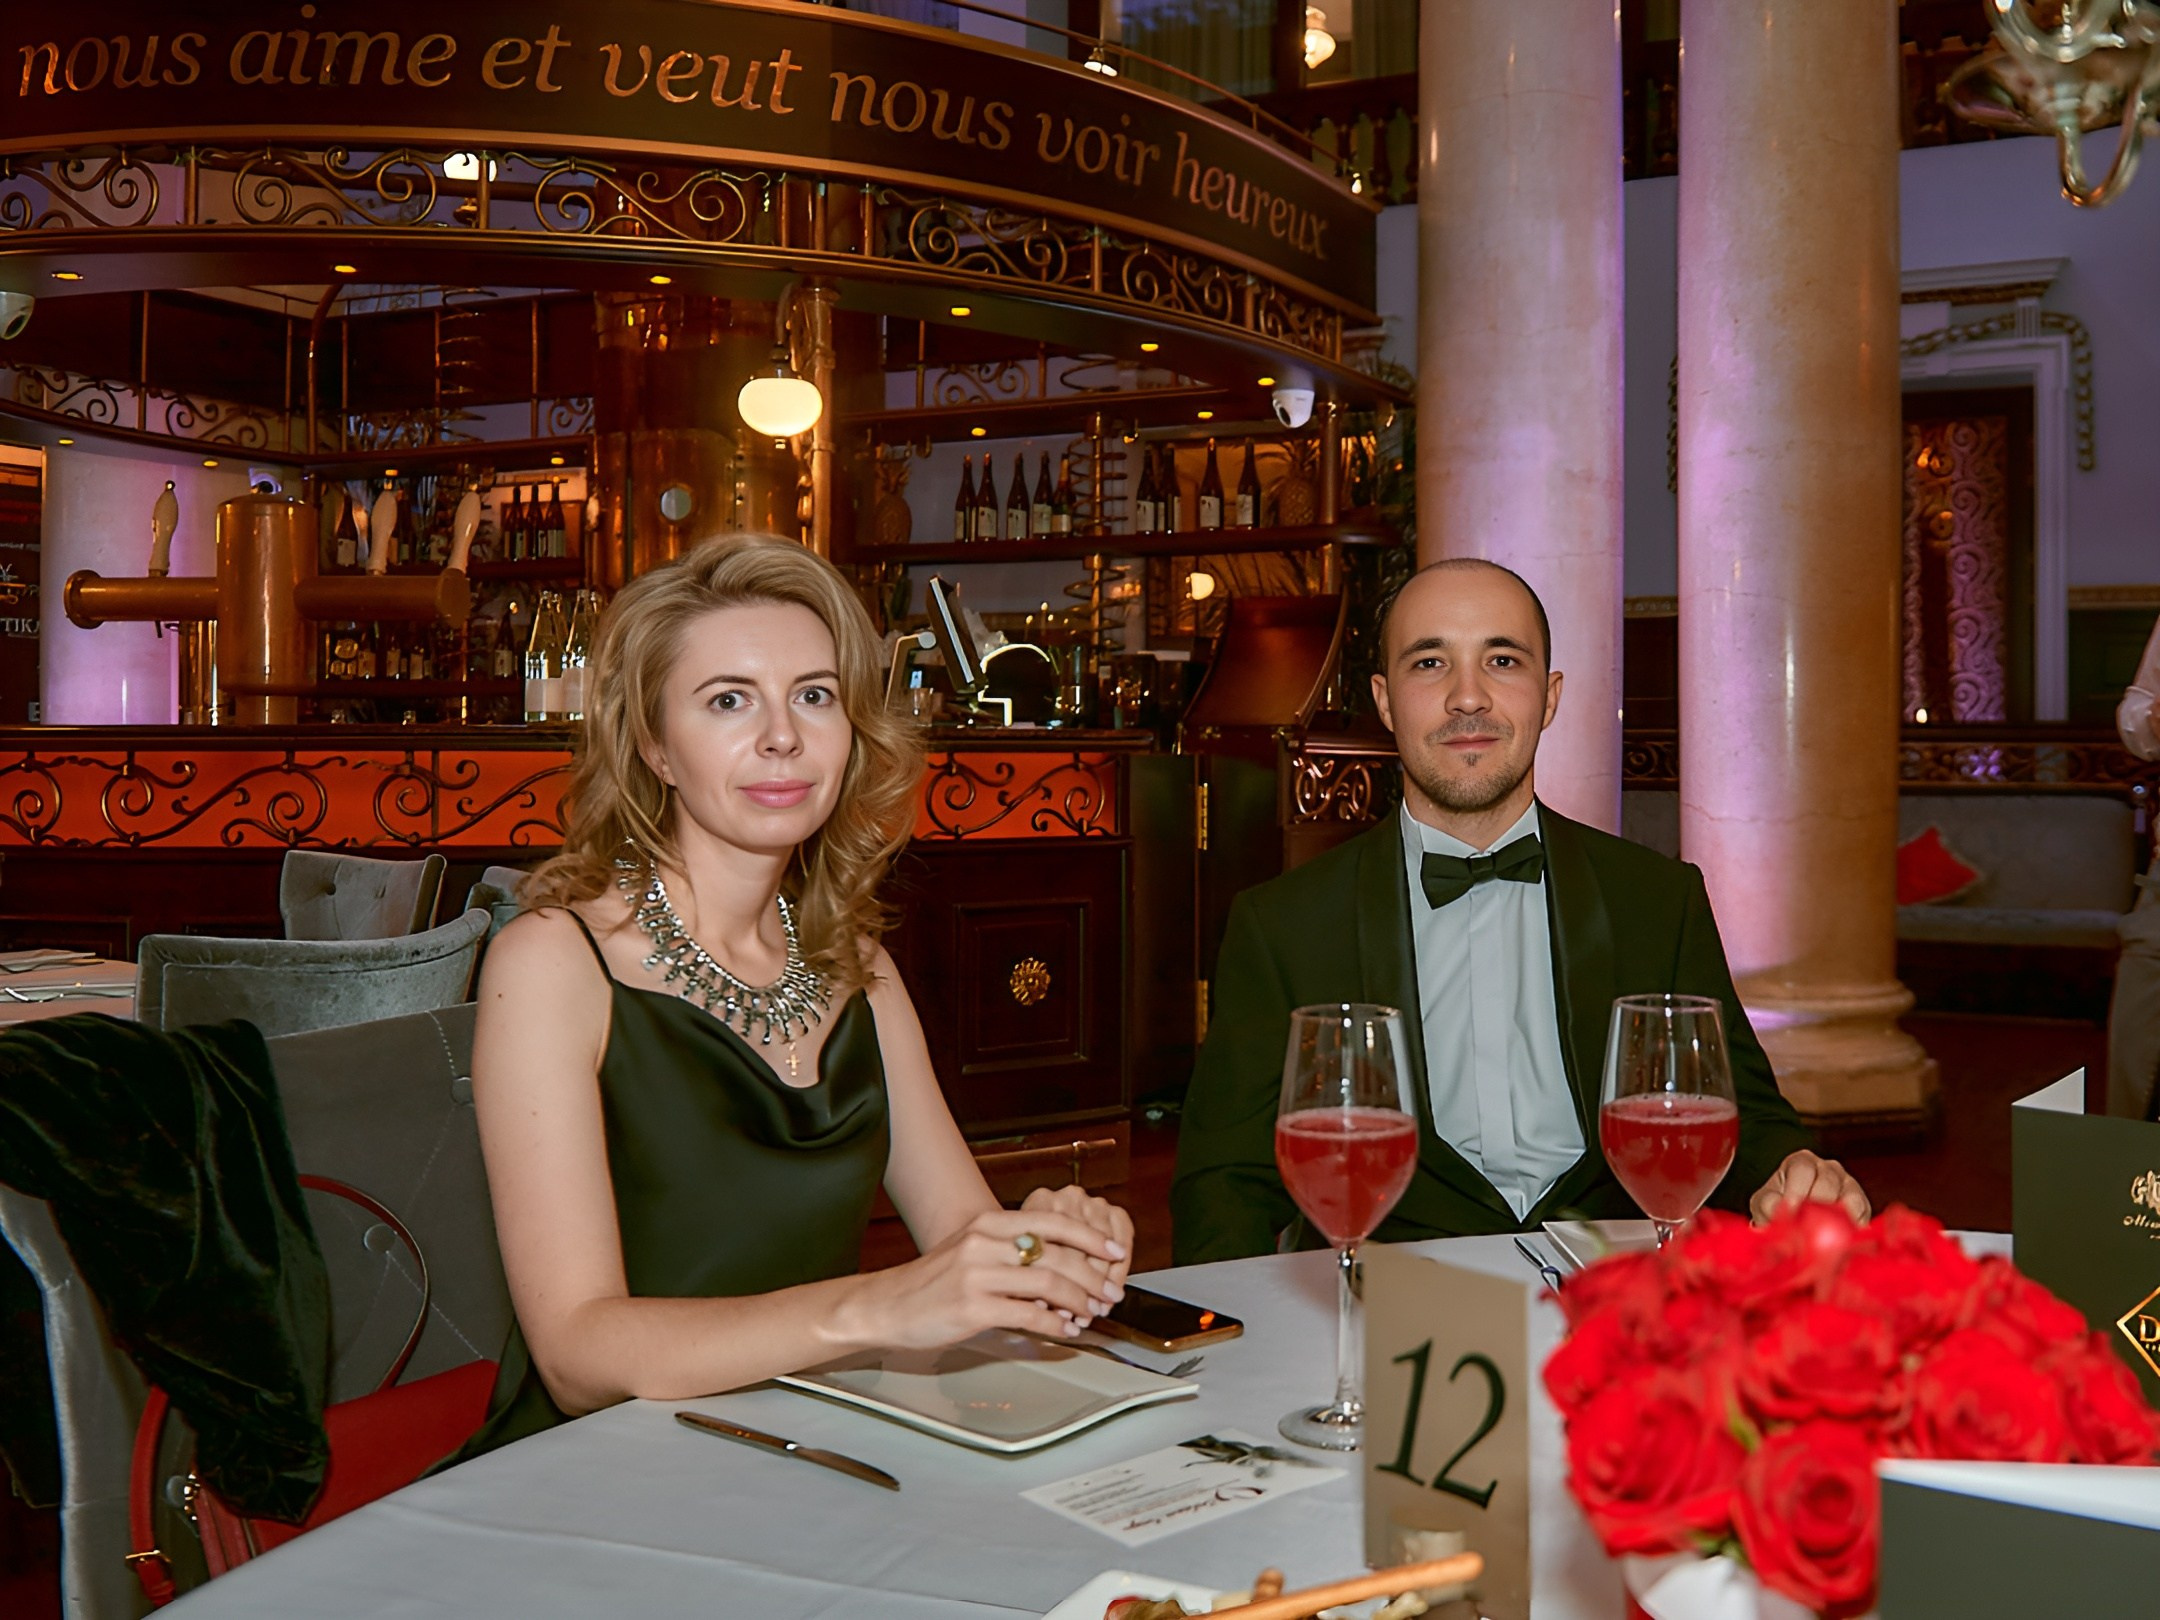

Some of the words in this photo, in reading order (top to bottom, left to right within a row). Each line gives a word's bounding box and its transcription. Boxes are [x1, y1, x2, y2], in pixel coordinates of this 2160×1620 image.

[19, 34, 206, 97] nous
[230, 4, 457, 86] aime
[481, 25, 571, 92] et
[600, 43, 803, 115] veut
[829, 72, 1014, 150] nous
[1036, 113, 1160, 187] voir
[1172, 132, 1328, 260] heureux
[1374, 1338, 1506, 1511] 12
